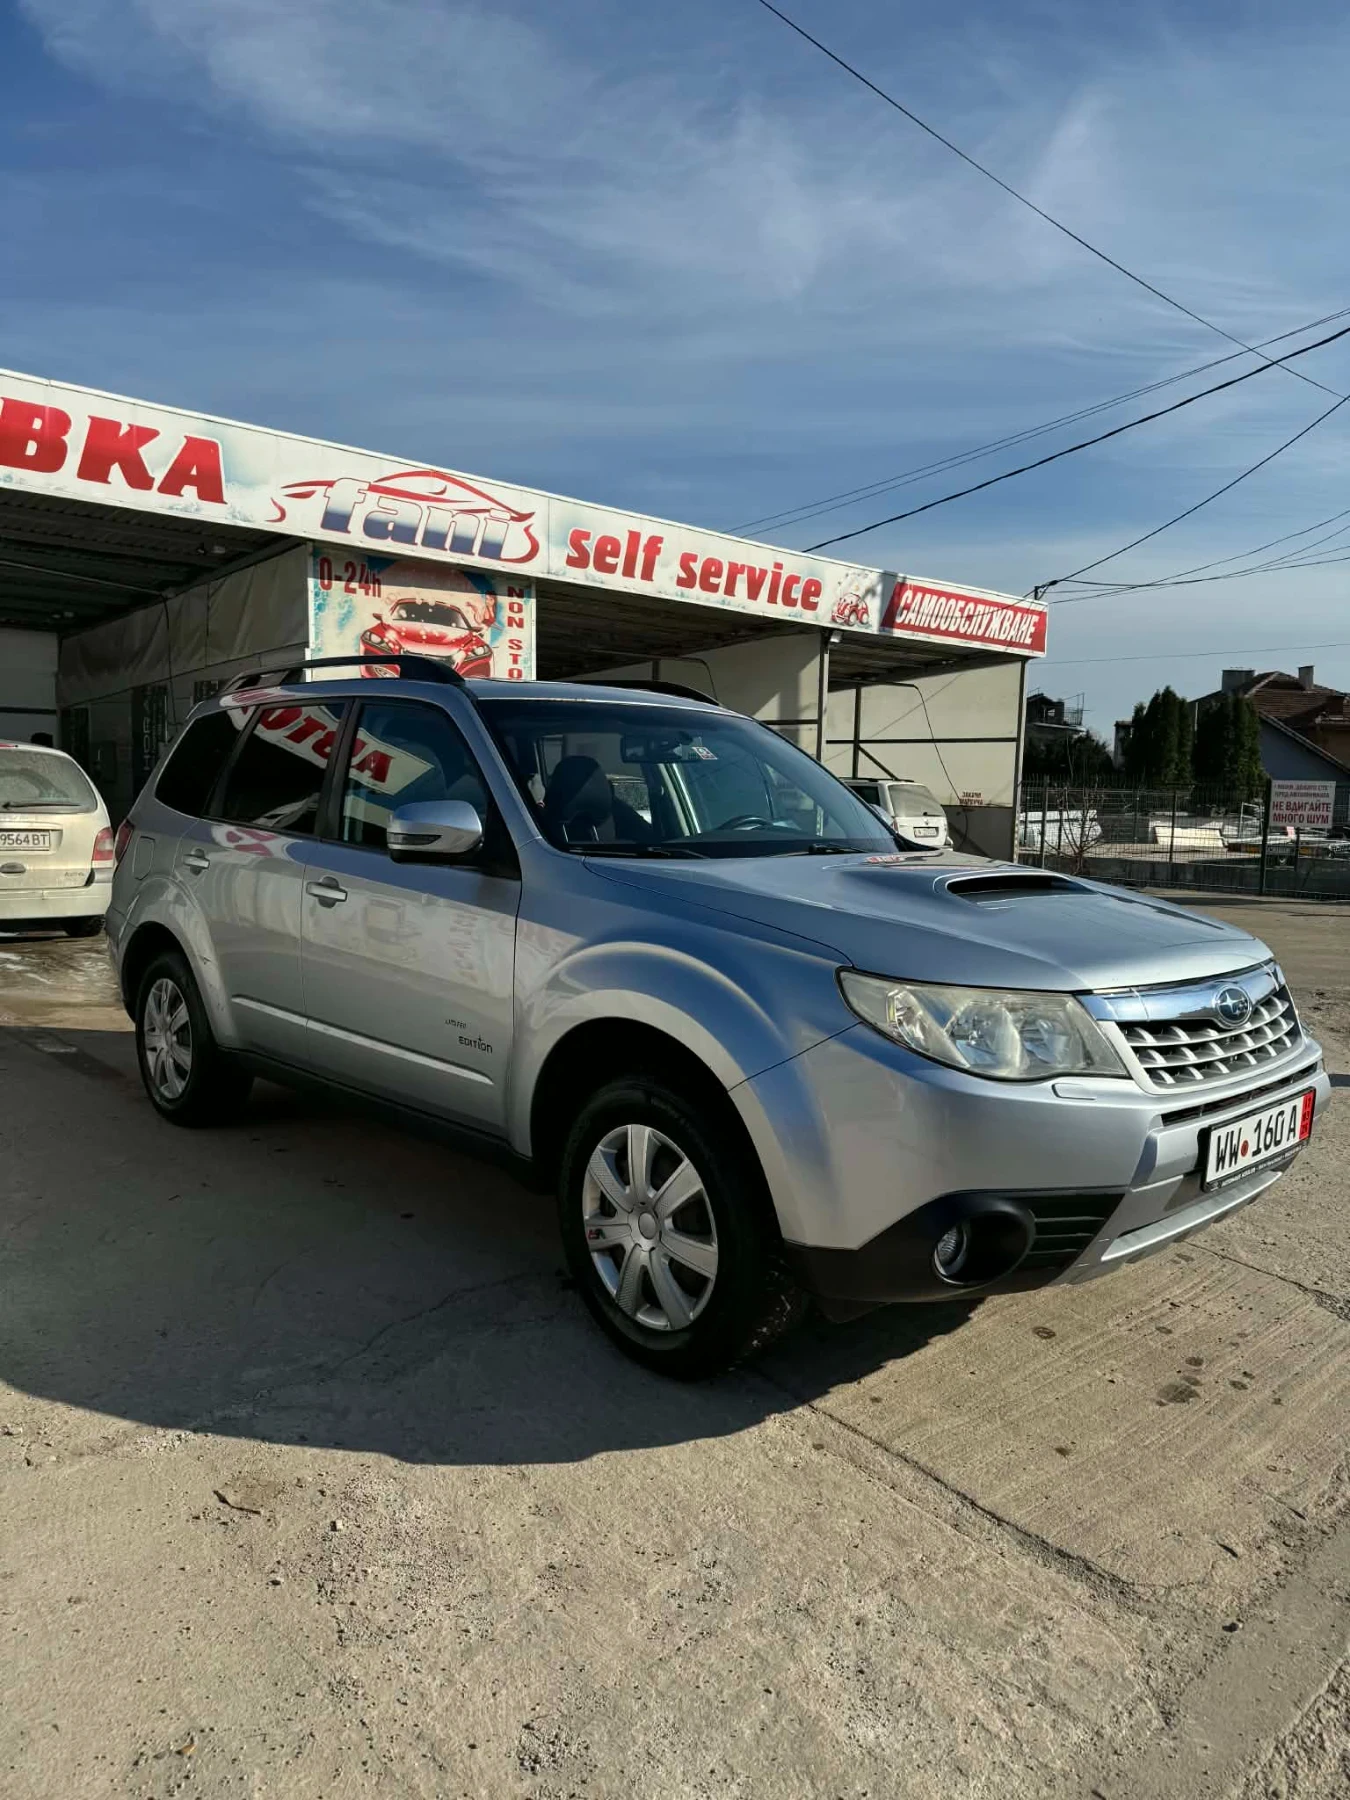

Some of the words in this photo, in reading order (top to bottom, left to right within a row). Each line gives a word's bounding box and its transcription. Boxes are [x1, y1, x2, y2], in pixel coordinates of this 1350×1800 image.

[320, 477, 509, 560] fani
[319, 557, 382, 598] 0-24h
[565, 528, 664, 582] self
[676, 551, 822, 611] service
[507, 586, 525, 629] NON
[895, 589, 1040, 645] САМООБСЛУЖВАНЕ
[1272, 801, 1285, 811] НЕ
[1286, 800, 1332, 813] ВДИГАЙТЕ
[1272, 812, 1304, 823] МНОГО
[1306, 814, 1329, 824] ШУМ
[1215, 1127, 1242, 1173] WW
[1251, 1110, 1285, 1157] 160
[1286, 1104, 1297, 1142] A
